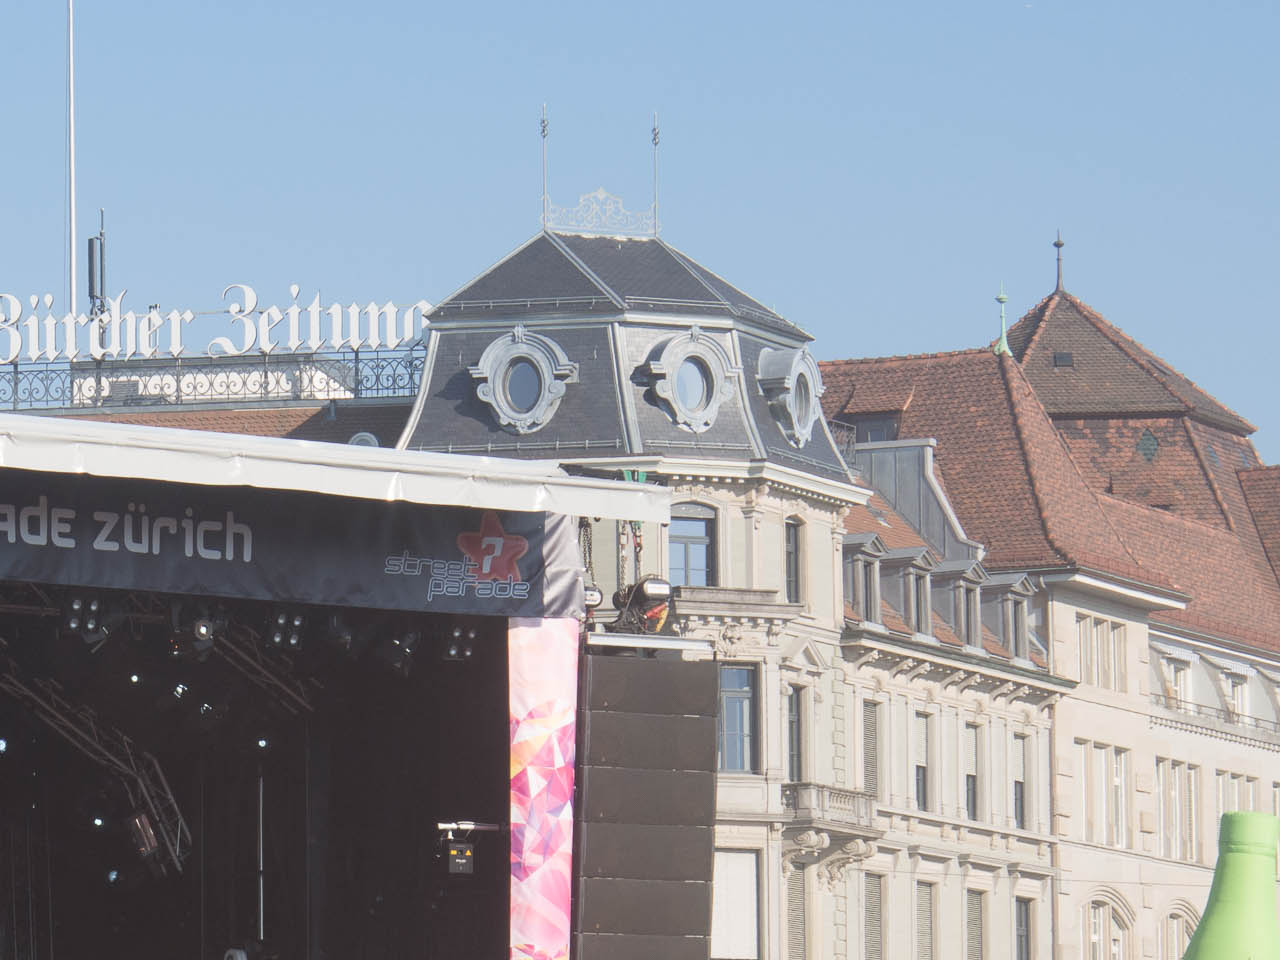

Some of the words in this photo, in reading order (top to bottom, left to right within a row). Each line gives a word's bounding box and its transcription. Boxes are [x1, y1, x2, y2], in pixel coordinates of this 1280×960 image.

[93, 502, 253, 563] zürich
[384, 550, 480, 579] street
[427, 575, 530, 601] parade
